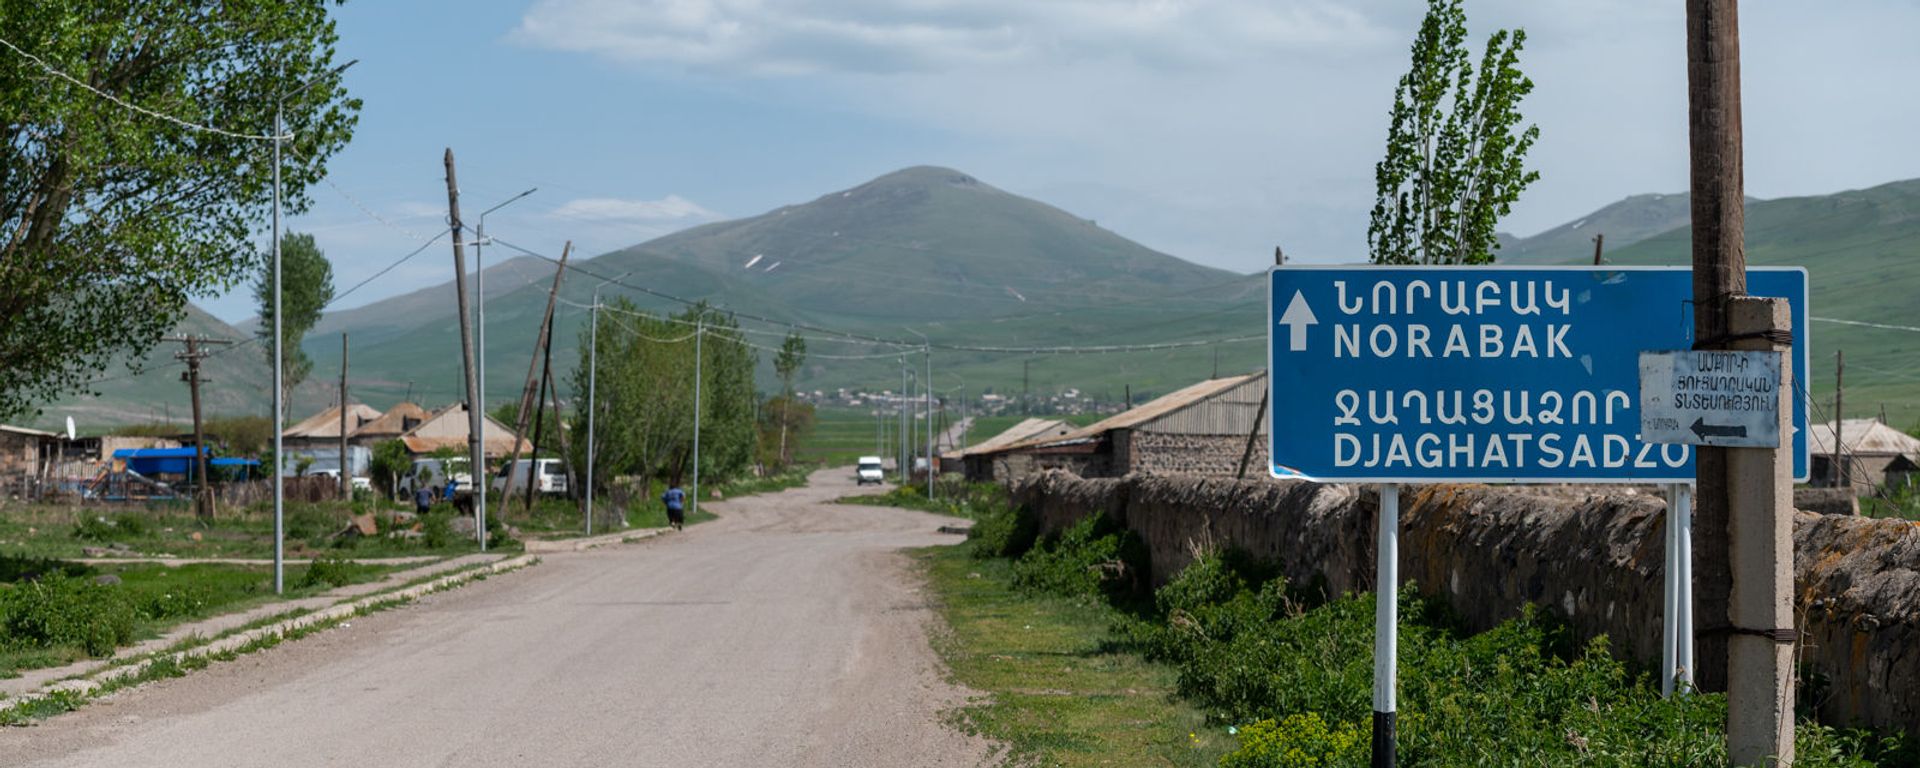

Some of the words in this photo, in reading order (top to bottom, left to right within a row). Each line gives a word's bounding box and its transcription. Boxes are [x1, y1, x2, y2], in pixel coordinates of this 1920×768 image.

[1334, 280, 1570, 315] ՆՈՐԱԲԱԿ
[1334, 324, 1573, 358] NORABAK
[1334, 390, 1630, 425] ՋԱՂԱՑԱՁՈՐ
